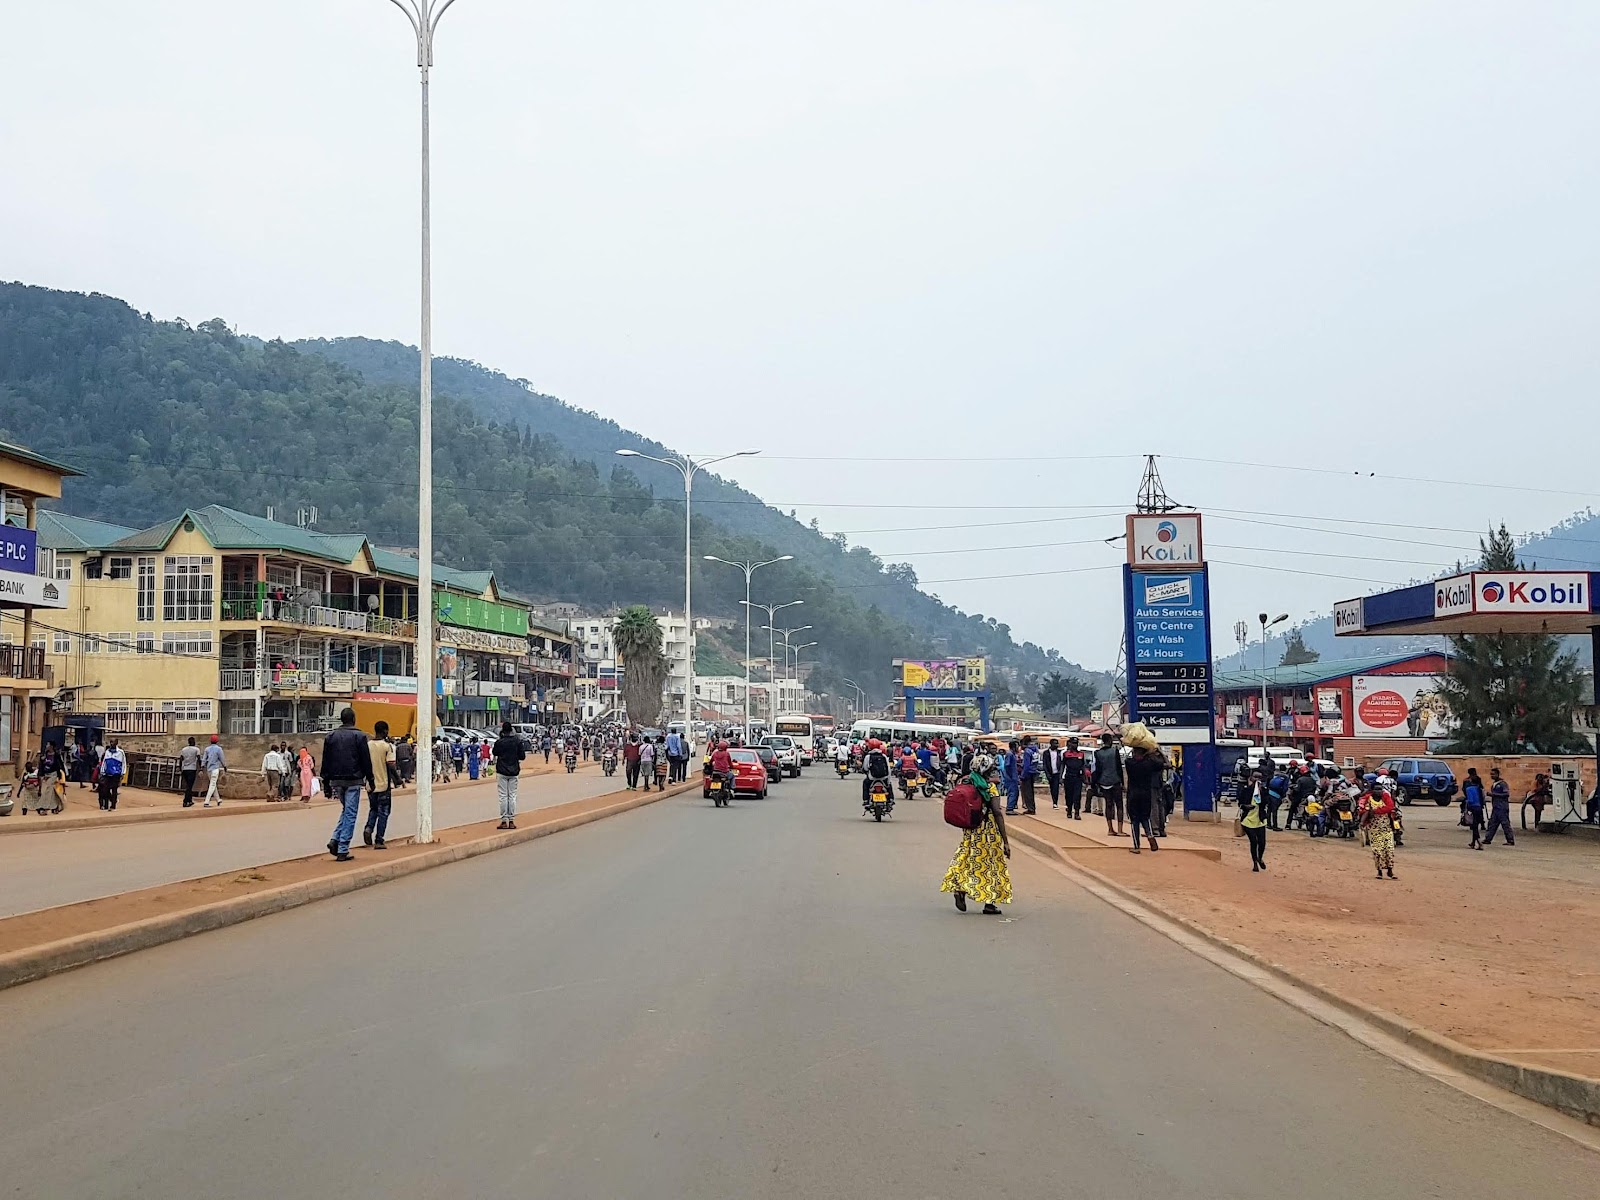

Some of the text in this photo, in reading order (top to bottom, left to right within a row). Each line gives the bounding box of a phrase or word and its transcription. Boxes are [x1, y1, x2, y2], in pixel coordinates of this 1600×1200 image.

[6, 542, 27, 561] PLC
[0, 579, 25, 595] BANK
[1148, 585, 1188, 599] K-MART
[1508, 581, 1583, 604] Kobil
[1444, 582, 1471, 608] Kobil
[1136, 608, 1204, 617] Auto Services
[1341, 607, 1360, 627] Kobil
[1136, 621, 1194, 632] Tyre Centre
[1136, 635, 1185, 644] Car Wash
[1137, 649, 1184, 658] 24 Hours
[1174, 682, 1206, 694] 1039
[1149, 716, 1177, 726] K-gas
